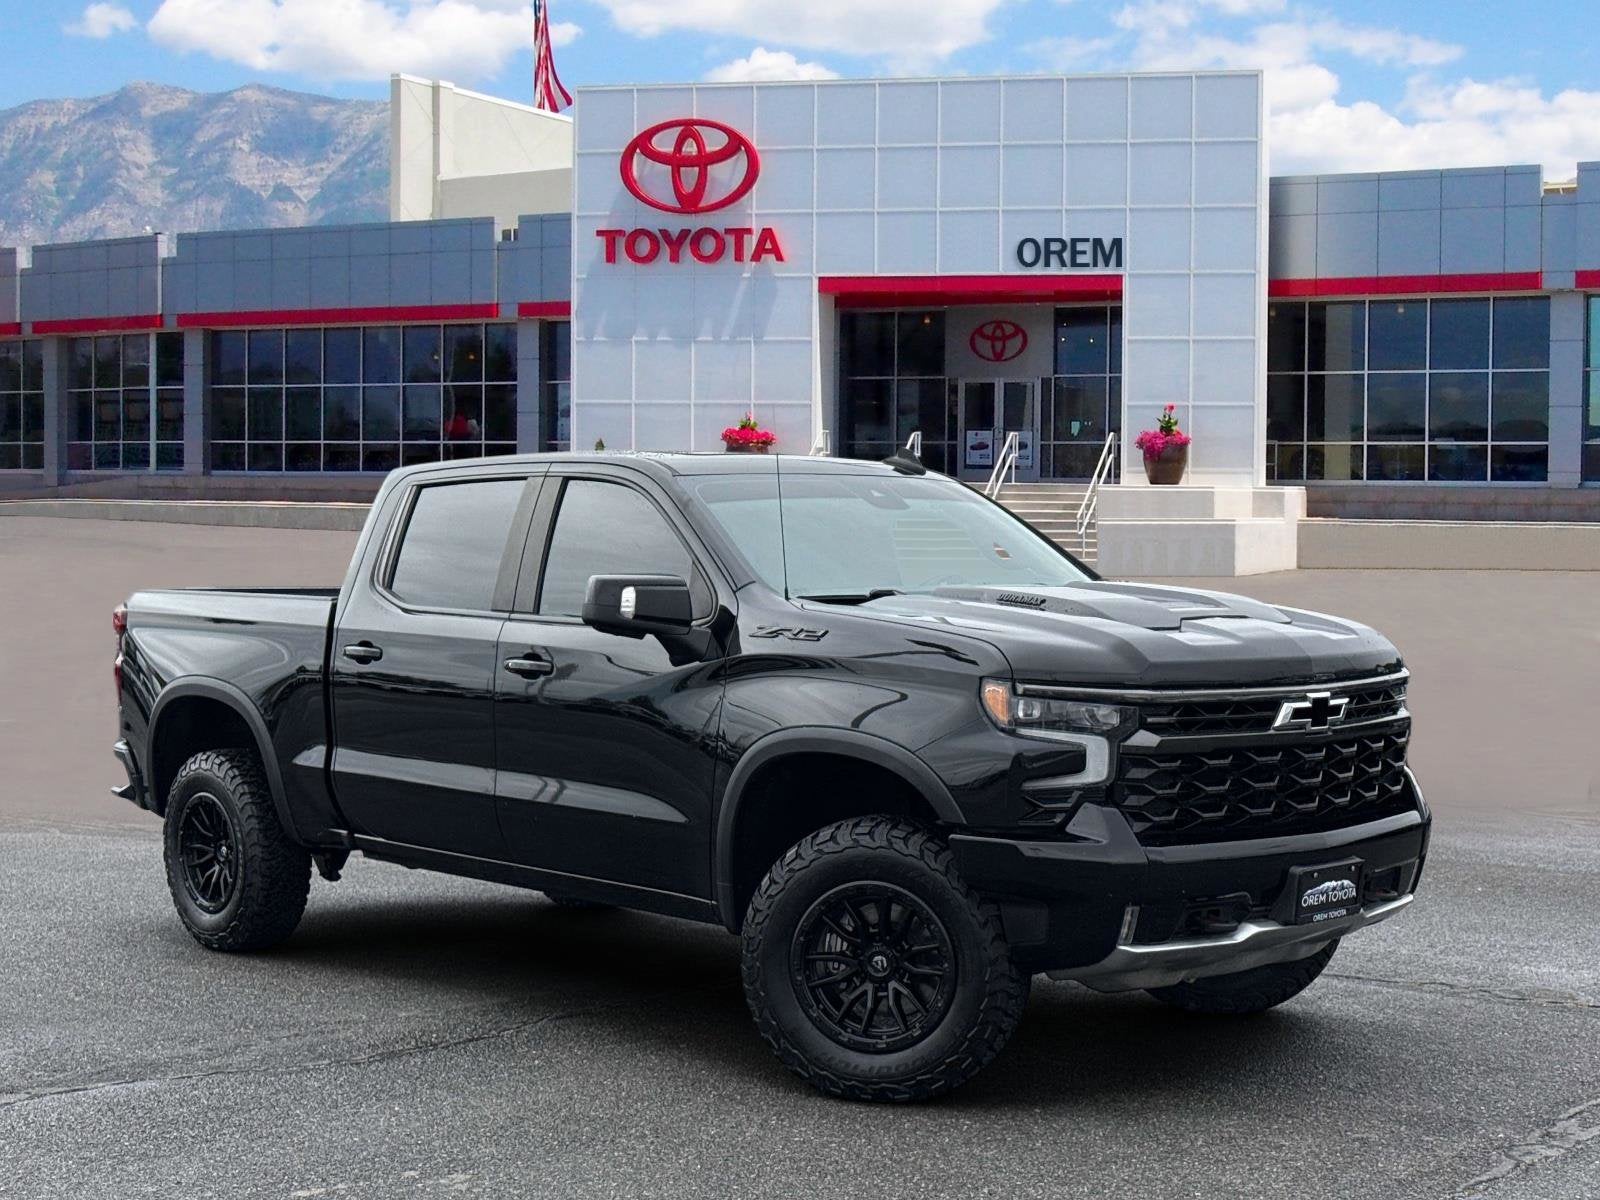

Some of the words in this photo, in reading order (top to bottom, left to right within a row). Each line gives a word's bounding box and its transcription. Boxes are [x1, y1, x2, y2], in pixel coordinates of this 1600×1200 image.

[596, 227, 784, 264] TOYOTA
[1017, 237, 1123, 267] OREM
[1301, 894, 1326, 907] OREM
[1328, 887, 1357, 902] TOYOTA
[1313, 912, 1328, 922] OREM
[1328, 909, 1347, 918] TOYOTA
